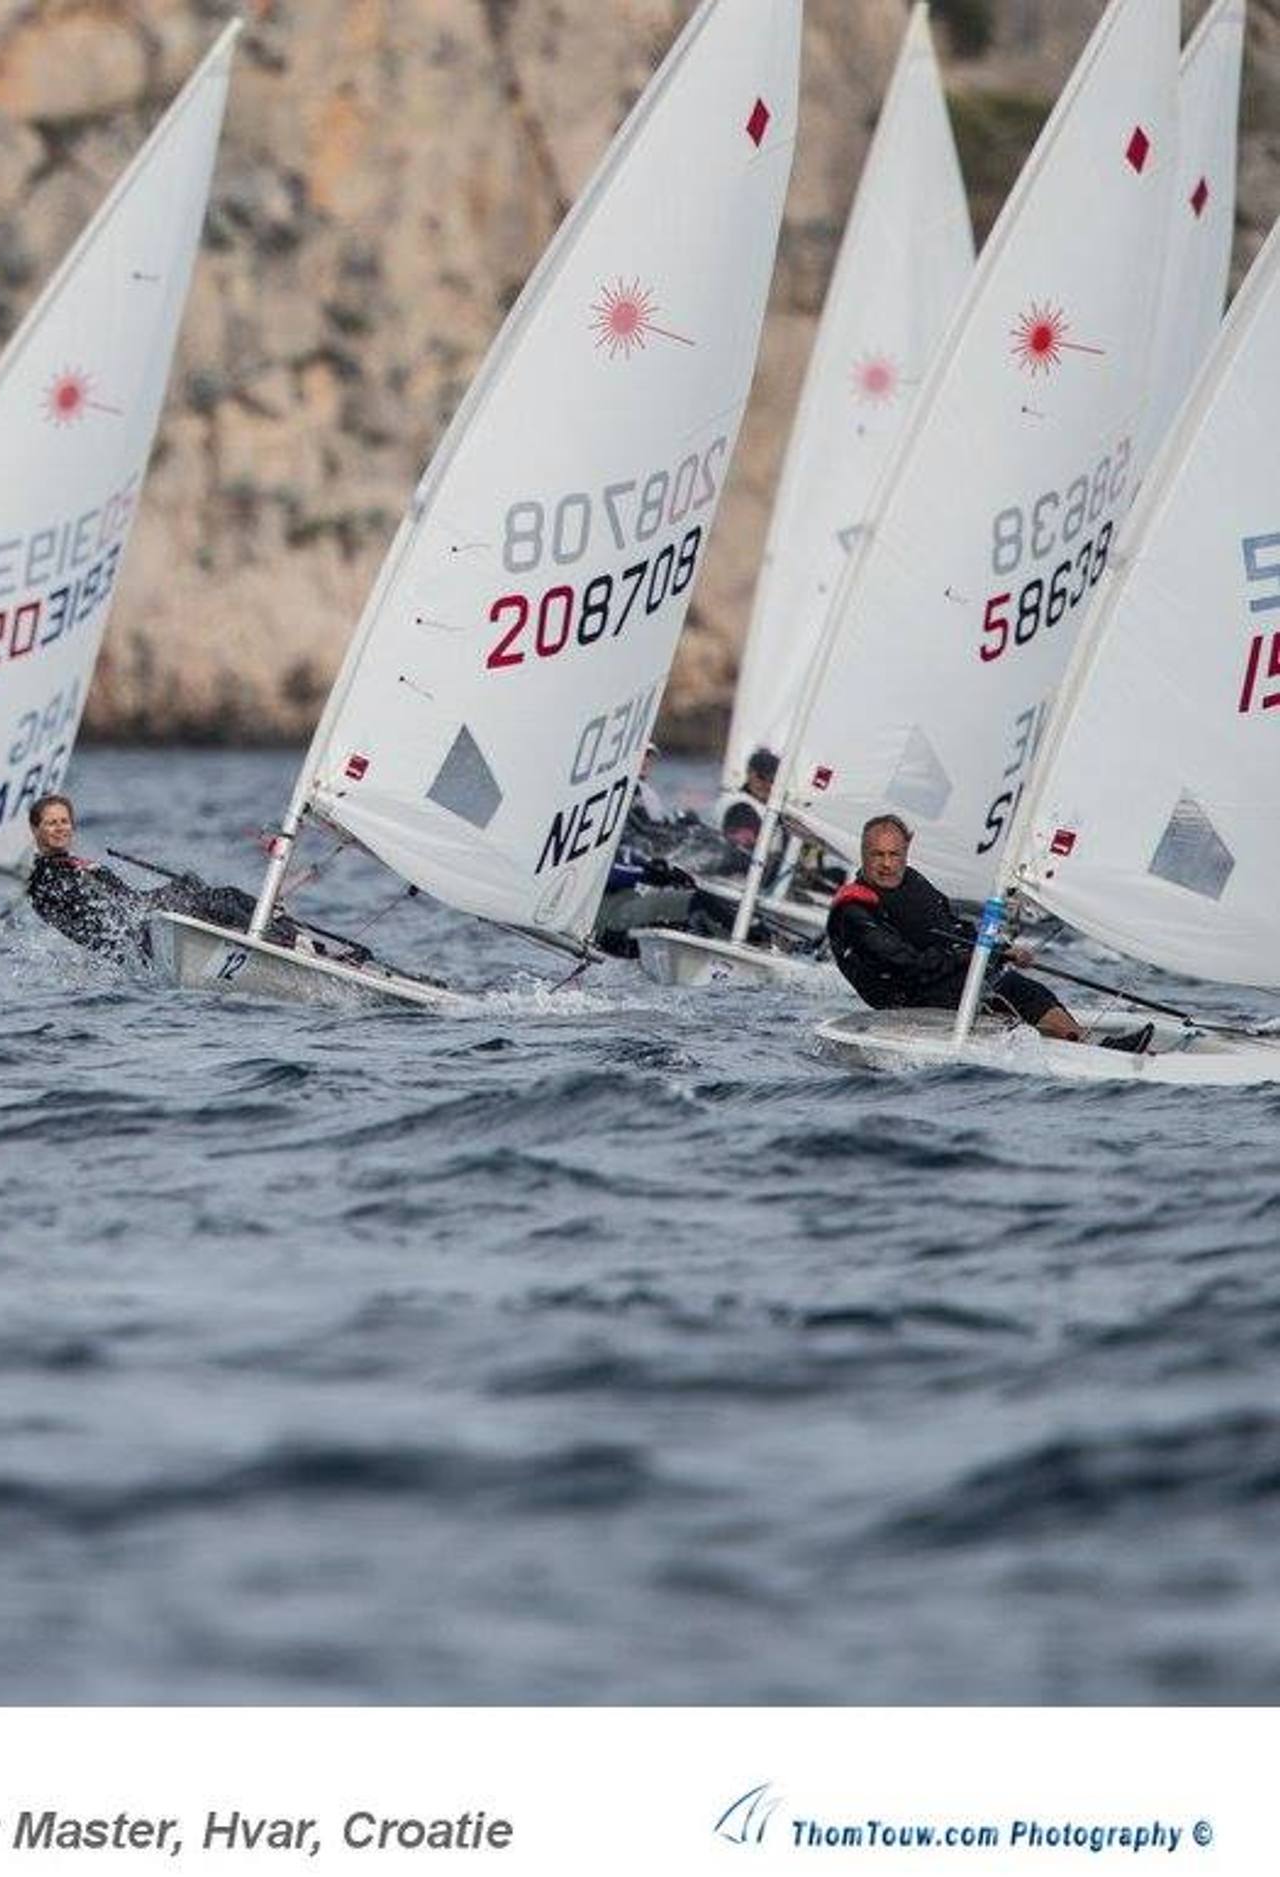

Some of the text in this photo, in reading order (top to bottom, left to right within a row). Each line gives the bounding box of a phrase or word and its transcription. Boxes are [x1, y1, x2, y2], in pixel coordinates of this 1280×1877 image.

[486, 523, 703, 669] 208708
[980, 519, 1114, 663] 58638
[535, 775, 630, 876] NED
